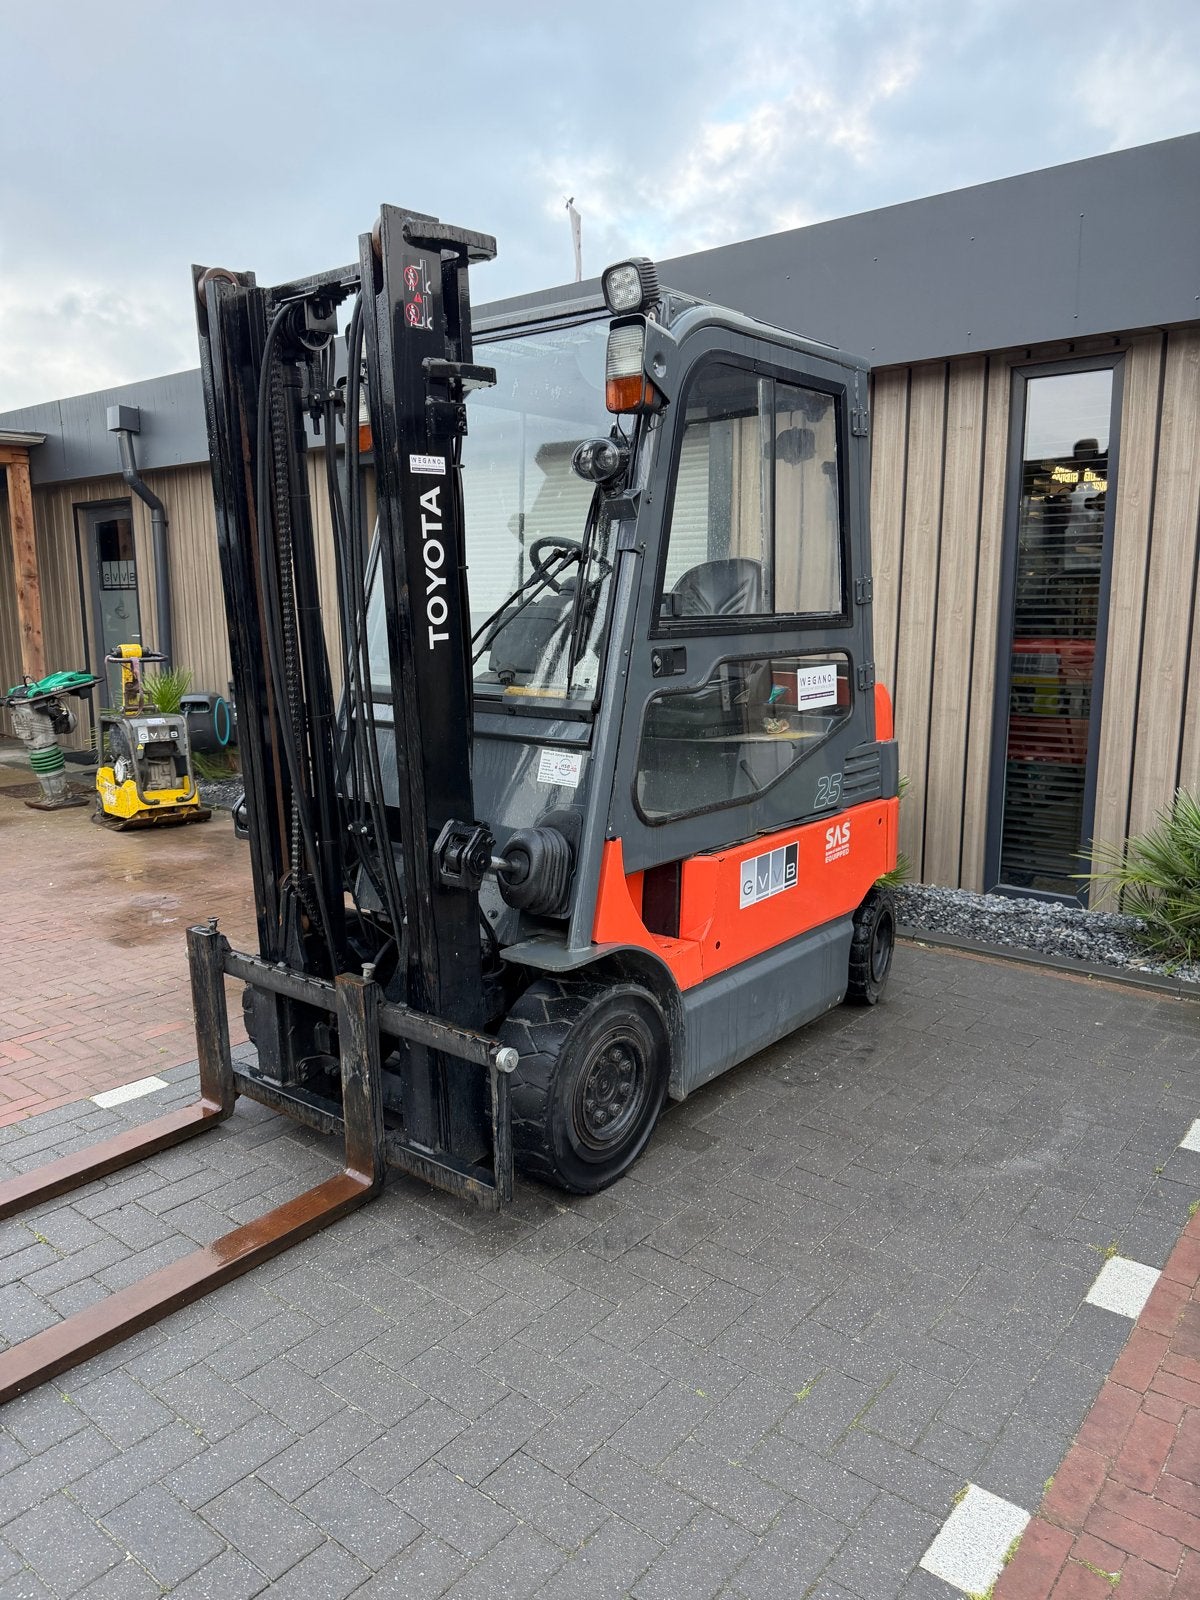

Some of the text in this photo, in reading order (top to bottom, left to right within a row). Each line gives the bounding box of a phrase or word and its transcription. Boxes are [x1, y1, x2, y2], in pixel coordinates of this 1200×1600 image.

[420, 485, 450, 650] TOYOTA
[800, 673, 832, 687] WEGANO
[814, 773, 842, 808] 25
[826, 821, 850, 850] SAS
[743, 862, 796, 896] GVVB
